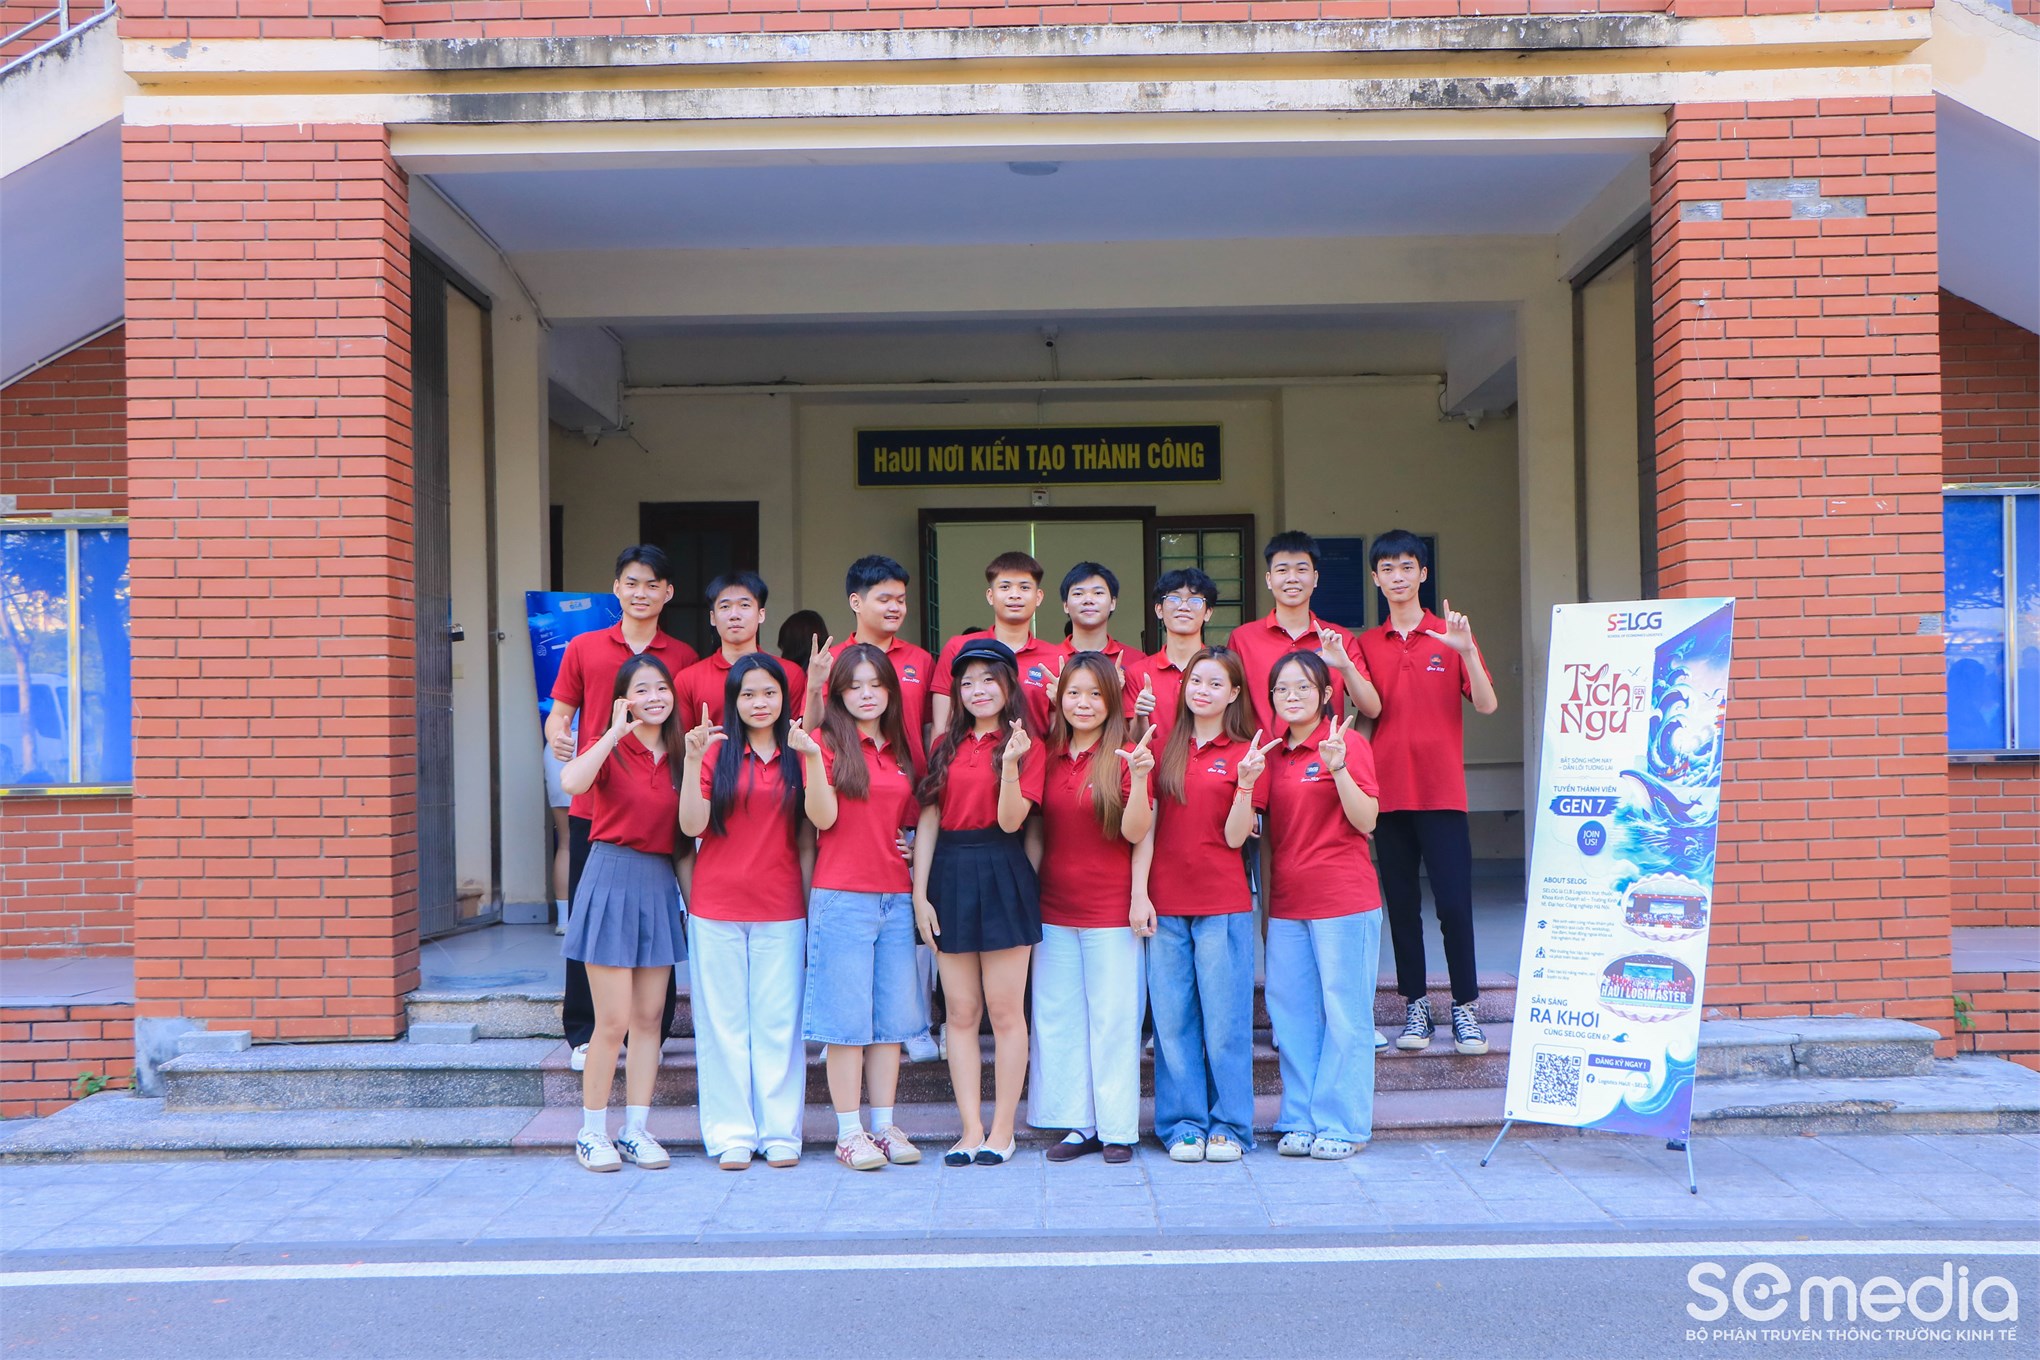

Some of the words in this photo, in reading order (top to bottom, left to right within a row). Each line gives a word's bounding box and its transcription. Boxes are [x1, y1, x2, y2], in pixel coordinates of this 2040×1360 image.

[874, 446, 921, 472] HaUI
[929, 445, 964, 472] NƠI
[971, 435, 1020, 471] KIẾN
[1026, 443, 1065, 476] TẠO
[1072, 438, 1140, 470] THÀNH
[1148, 437, 1205, 469] CÔNG
[1564, 663, 1631, 706] Tích
[1635, 695, 1643, 709] 7
[1560, 703, 1631, 741] Ngư
[1560, 799, 1593, 814] GEN
[1597, 799, 1606, 814] 7
[1583, 830, 1600, 839] JOIN
[1601, 984, 1624, 998] HAUI
[1626, 987, 1687, 1003] LOGIMASTER
[1530, 1007, 1552, 1024] RA
[1557, 1009, 1600, 1028] KHƠI
[1564, 1030, 1586, 1038] SELOG
[1587, 1032, 1601, 1040] GEN
[1624, 1061, 1643, 1069] NGAY
